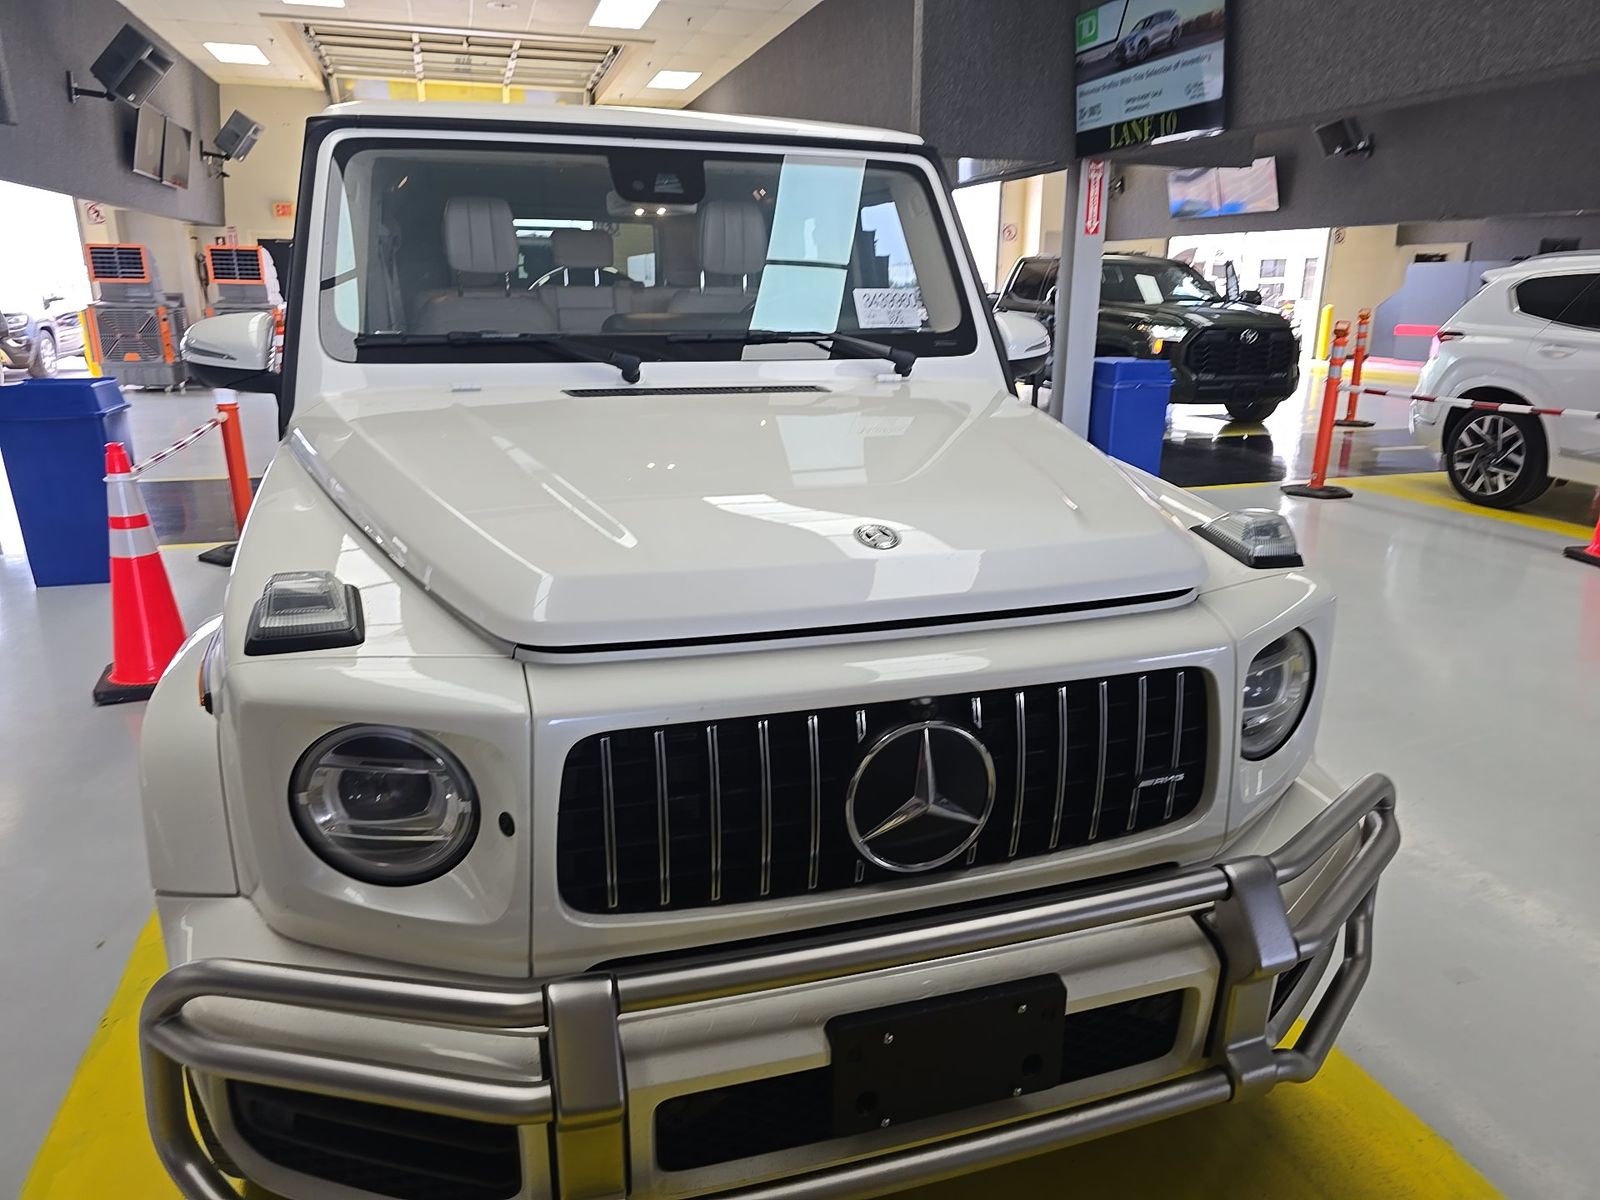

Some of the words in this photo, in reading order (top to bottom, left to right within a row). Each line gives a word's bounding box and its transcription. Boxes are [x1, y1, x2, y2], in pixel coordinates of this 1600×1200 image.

[1079, 16, 1096, 40] TD
[1109, 115, 1156, 149] LANE
[1160, 111, 1178, 137] 10
